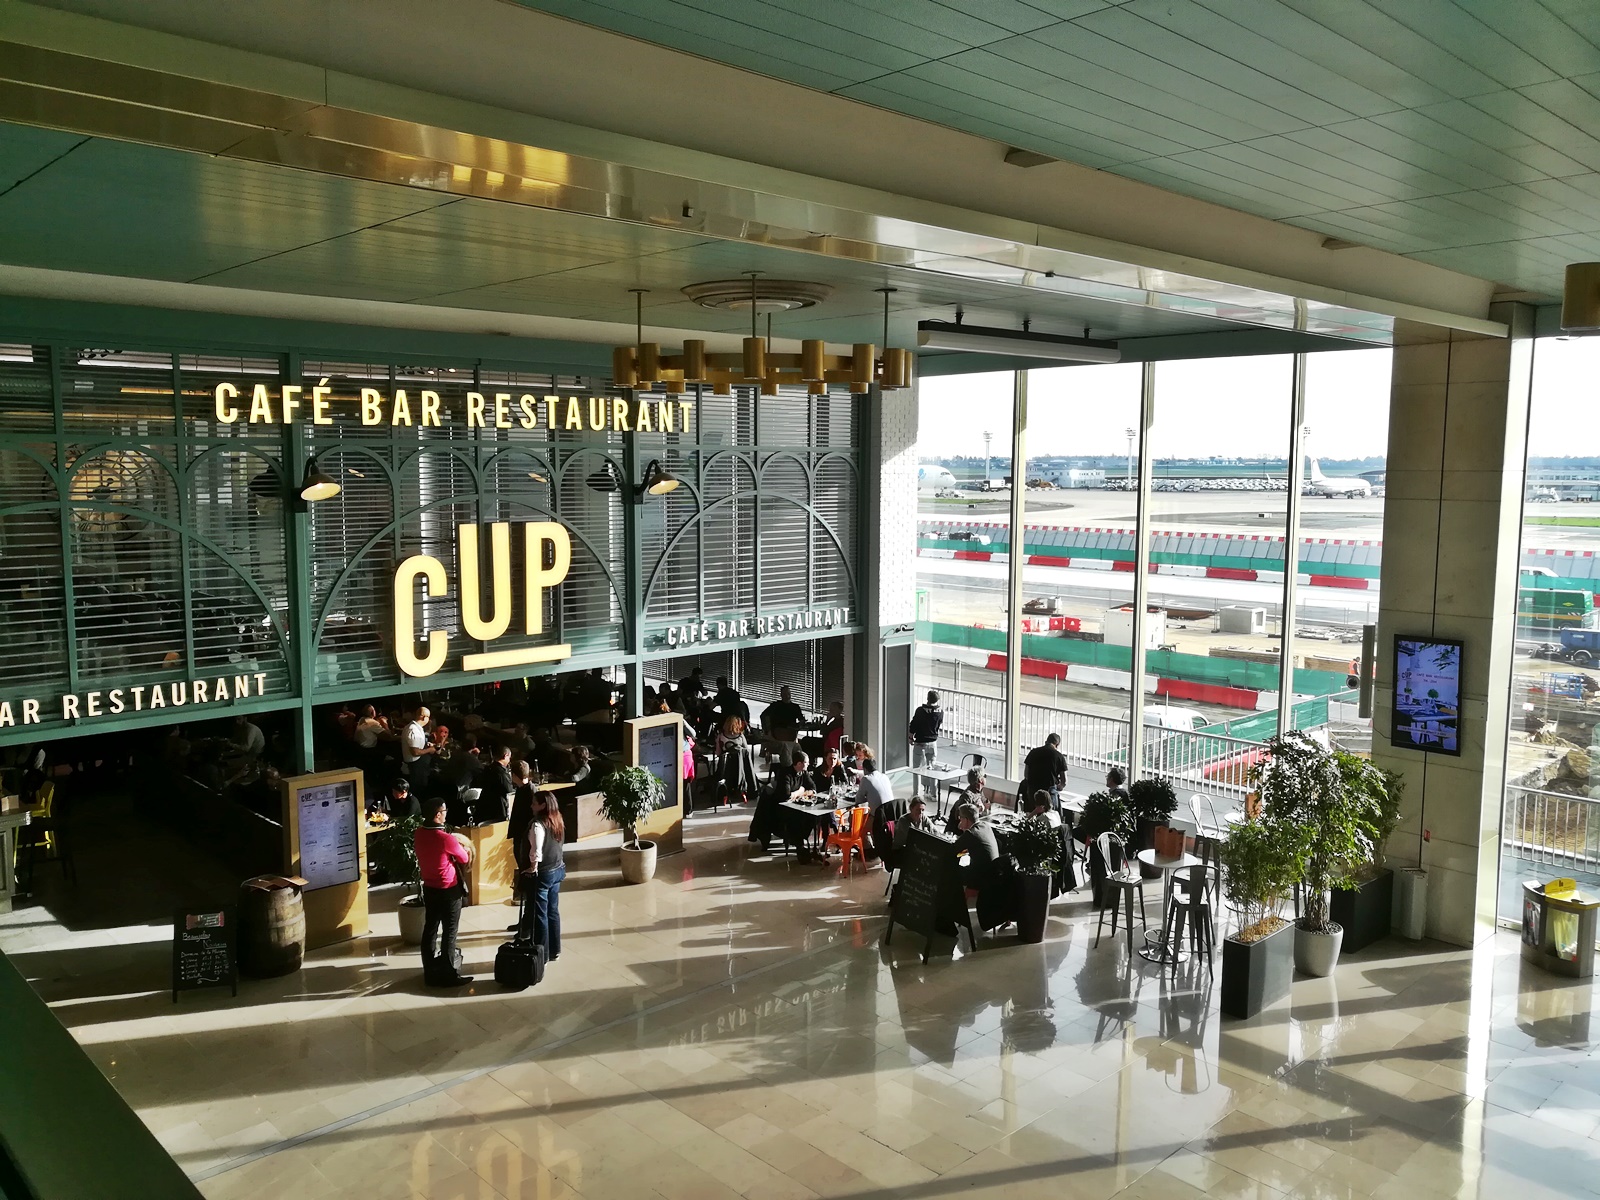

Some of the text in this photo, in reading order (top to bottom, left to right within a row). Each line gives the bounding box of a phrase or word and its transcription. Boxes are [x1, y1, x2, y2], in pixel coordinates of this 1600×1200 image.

[215, 378, 693, 433] CAFÉ BAR RESTAURANT
[394, 522, 572, 677] CUP
[668, 609, 850, 646] CAFÉ BAR RESTAURANT
[62, 673, 267, 720] RESTAURANT
